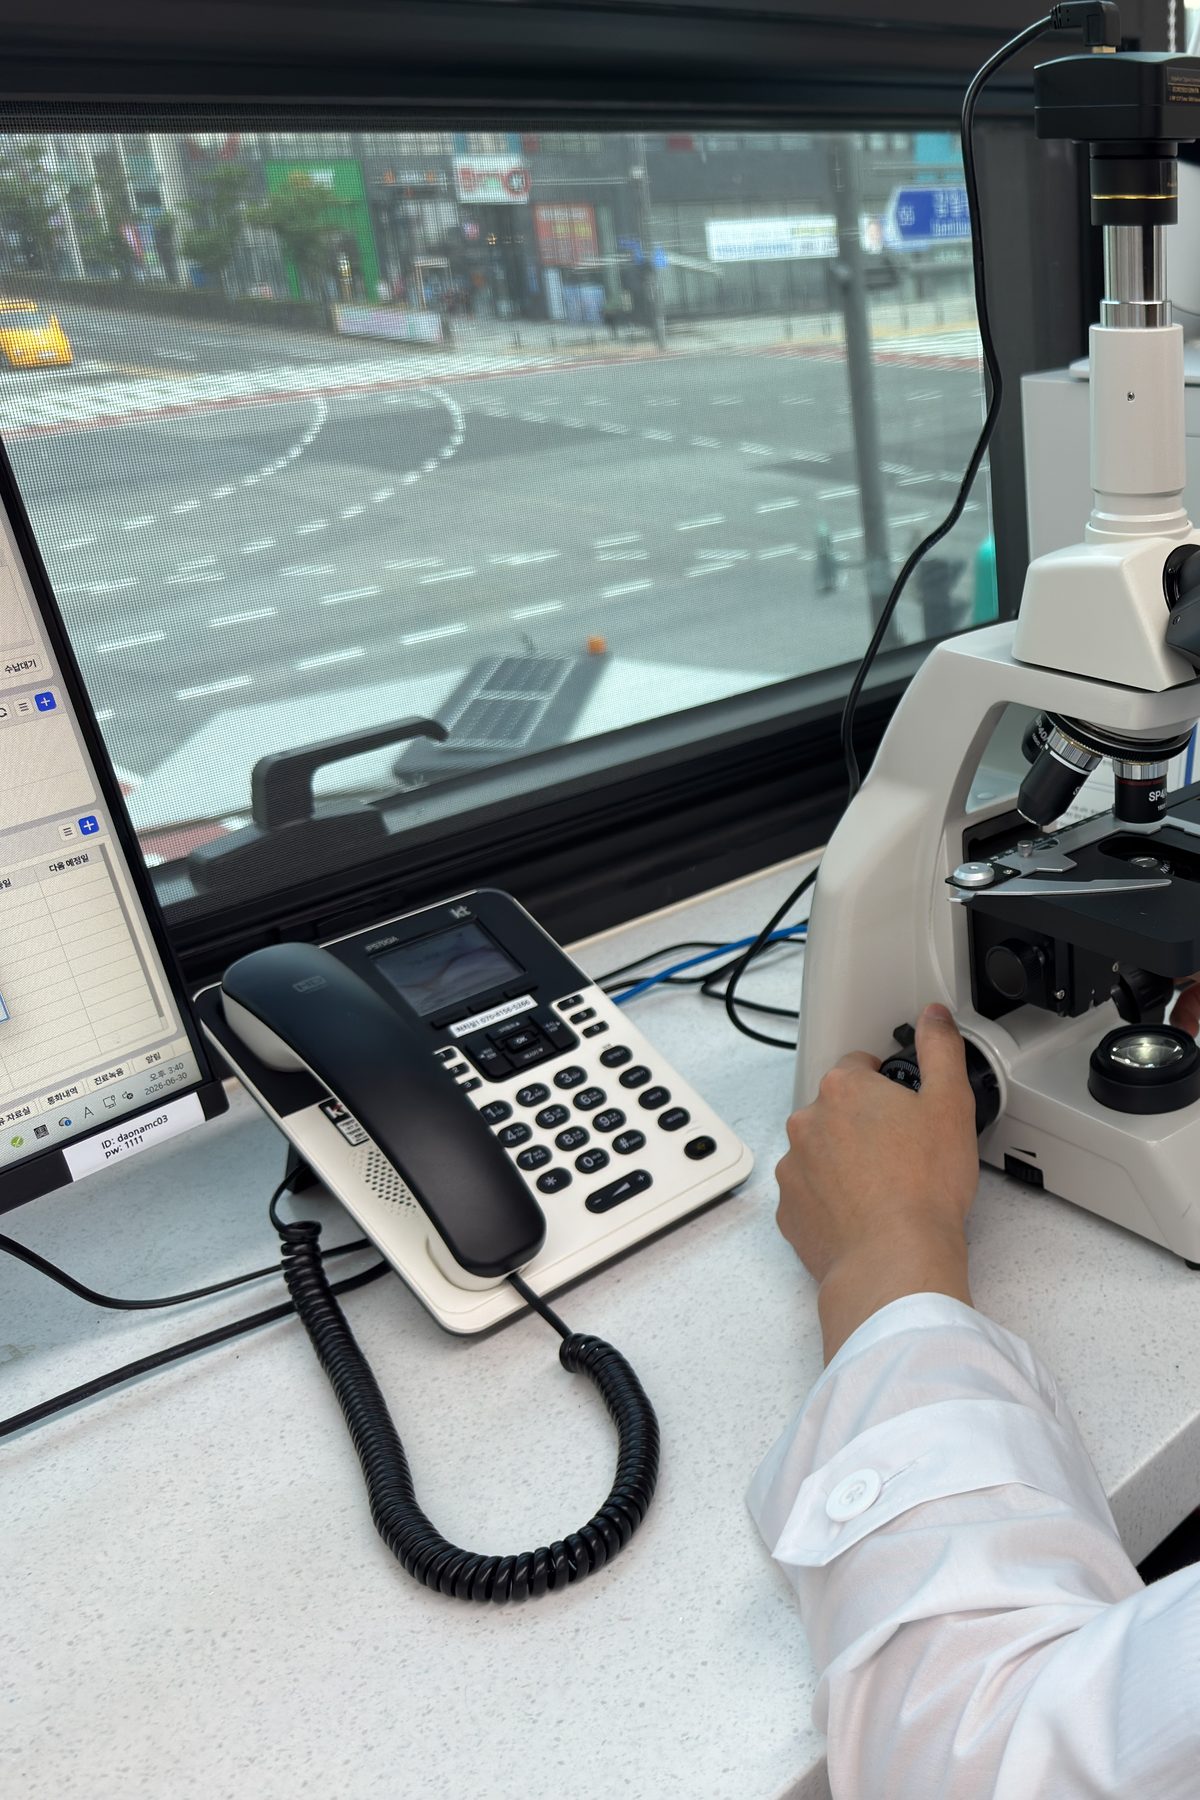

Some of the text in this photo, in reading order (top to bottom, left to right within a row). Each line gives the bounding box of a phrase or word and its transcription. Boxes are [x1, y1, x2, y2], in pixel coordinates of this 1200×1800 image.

[5, 658, 37, 673] 수납대기
[48, 853, 90, 872] 다음 예정일
[449, 905, 472, 919] kt
[145, 1051, 162, 1065] 알림
[149, 1062, 185, 1082] 오후 3:40
[560, 1072, 573, 1085] 3
[145, 1072, 188, 1096] 2026-06-30
[47, 1086, 79, 1106] 통화내역
[523, 1090, 537, 1102] 2
[580, 1093, 592, 1105] 6
[543, 1110, 555, 1123] 5
[599, 1115, 611, 1127] 9
[101, 1114, 169, 1150] ID: daonamc03
[506, 1128, 517, 1141] 4
[562, 1133, 574, 1146] 8
[104, 1135, 144, 1159] pw: 1111
[523, 1150, 534, 1165] 7
[583, 1156, 595, 1168] 0
